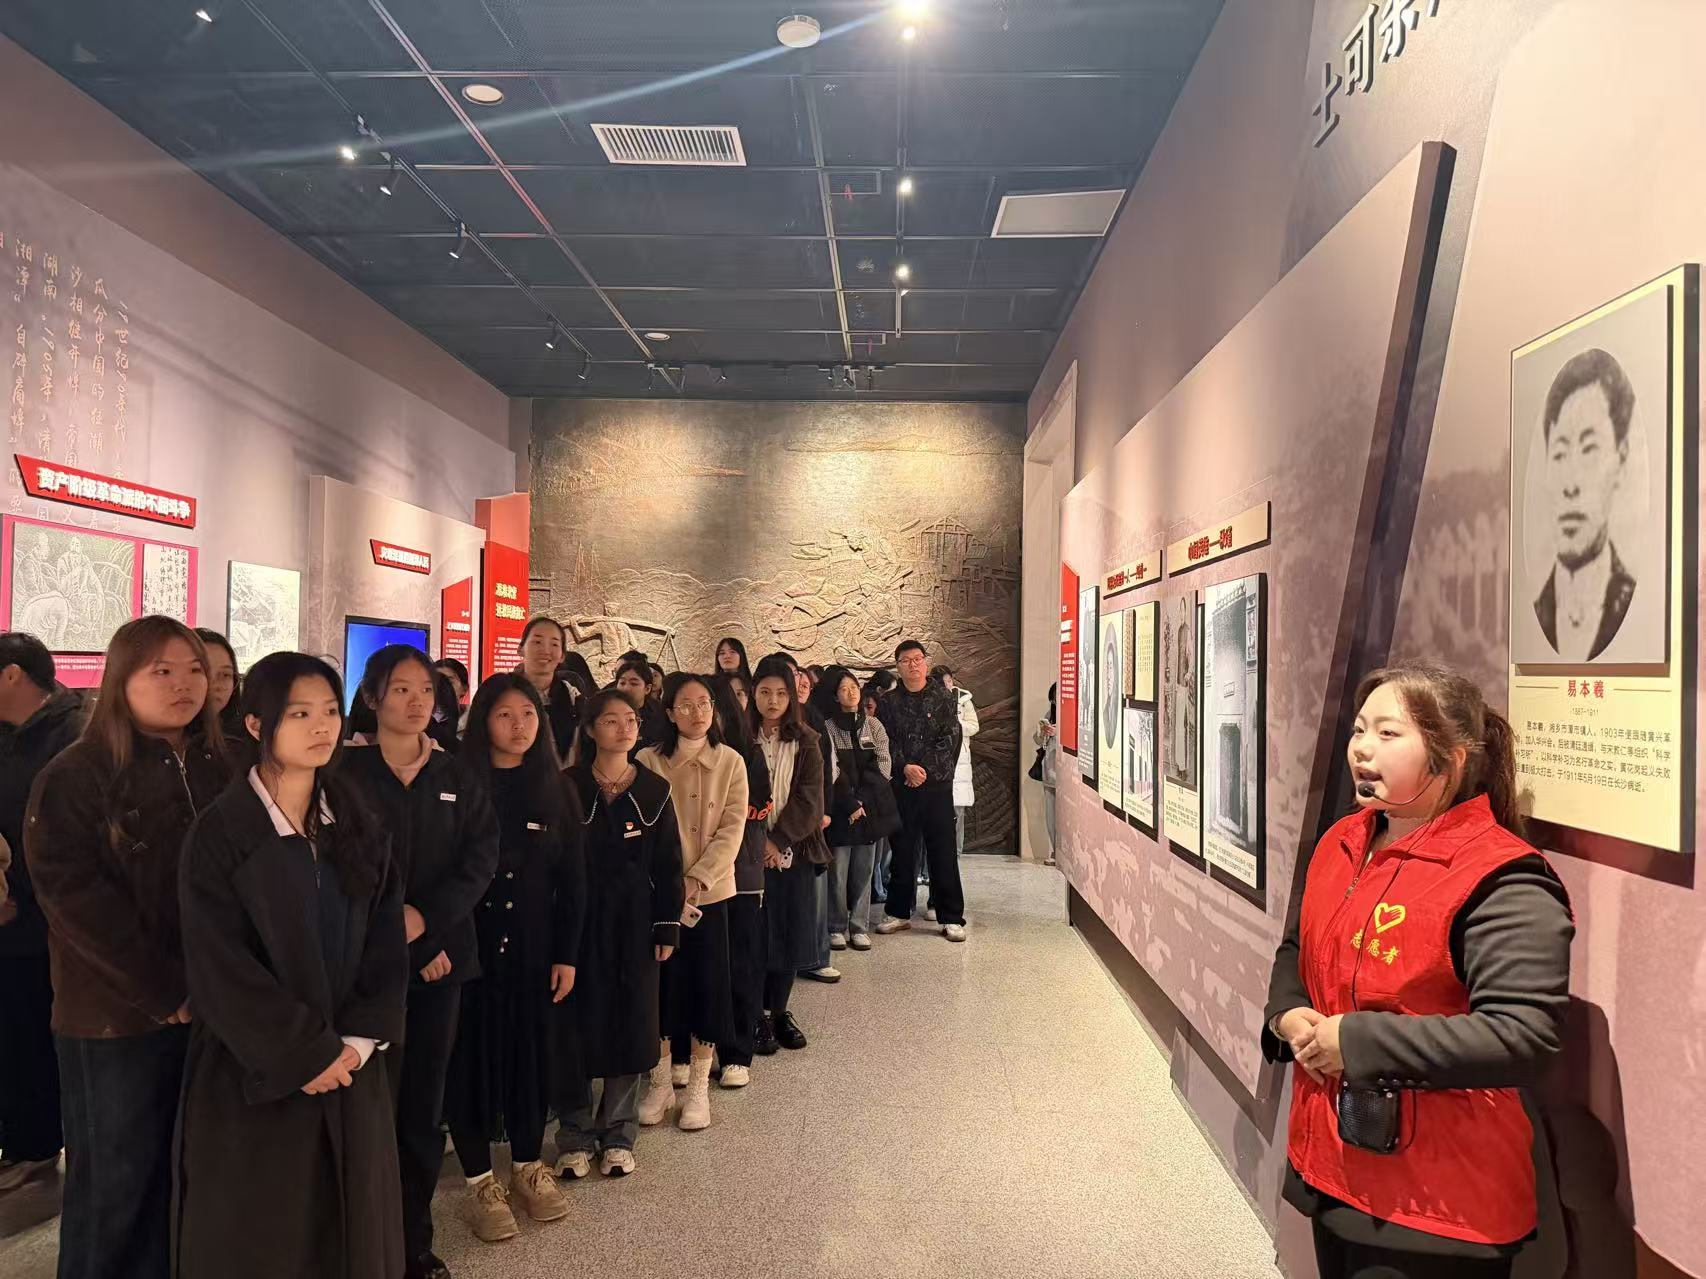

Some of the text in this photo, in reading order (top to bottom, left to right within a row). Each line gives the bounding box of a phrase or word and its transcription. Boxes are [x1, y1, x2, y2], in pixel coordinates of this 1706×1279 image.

[1312, 0, 1440, 148] 士可杀
[1350, 928, 1400, 966] 志愿者
